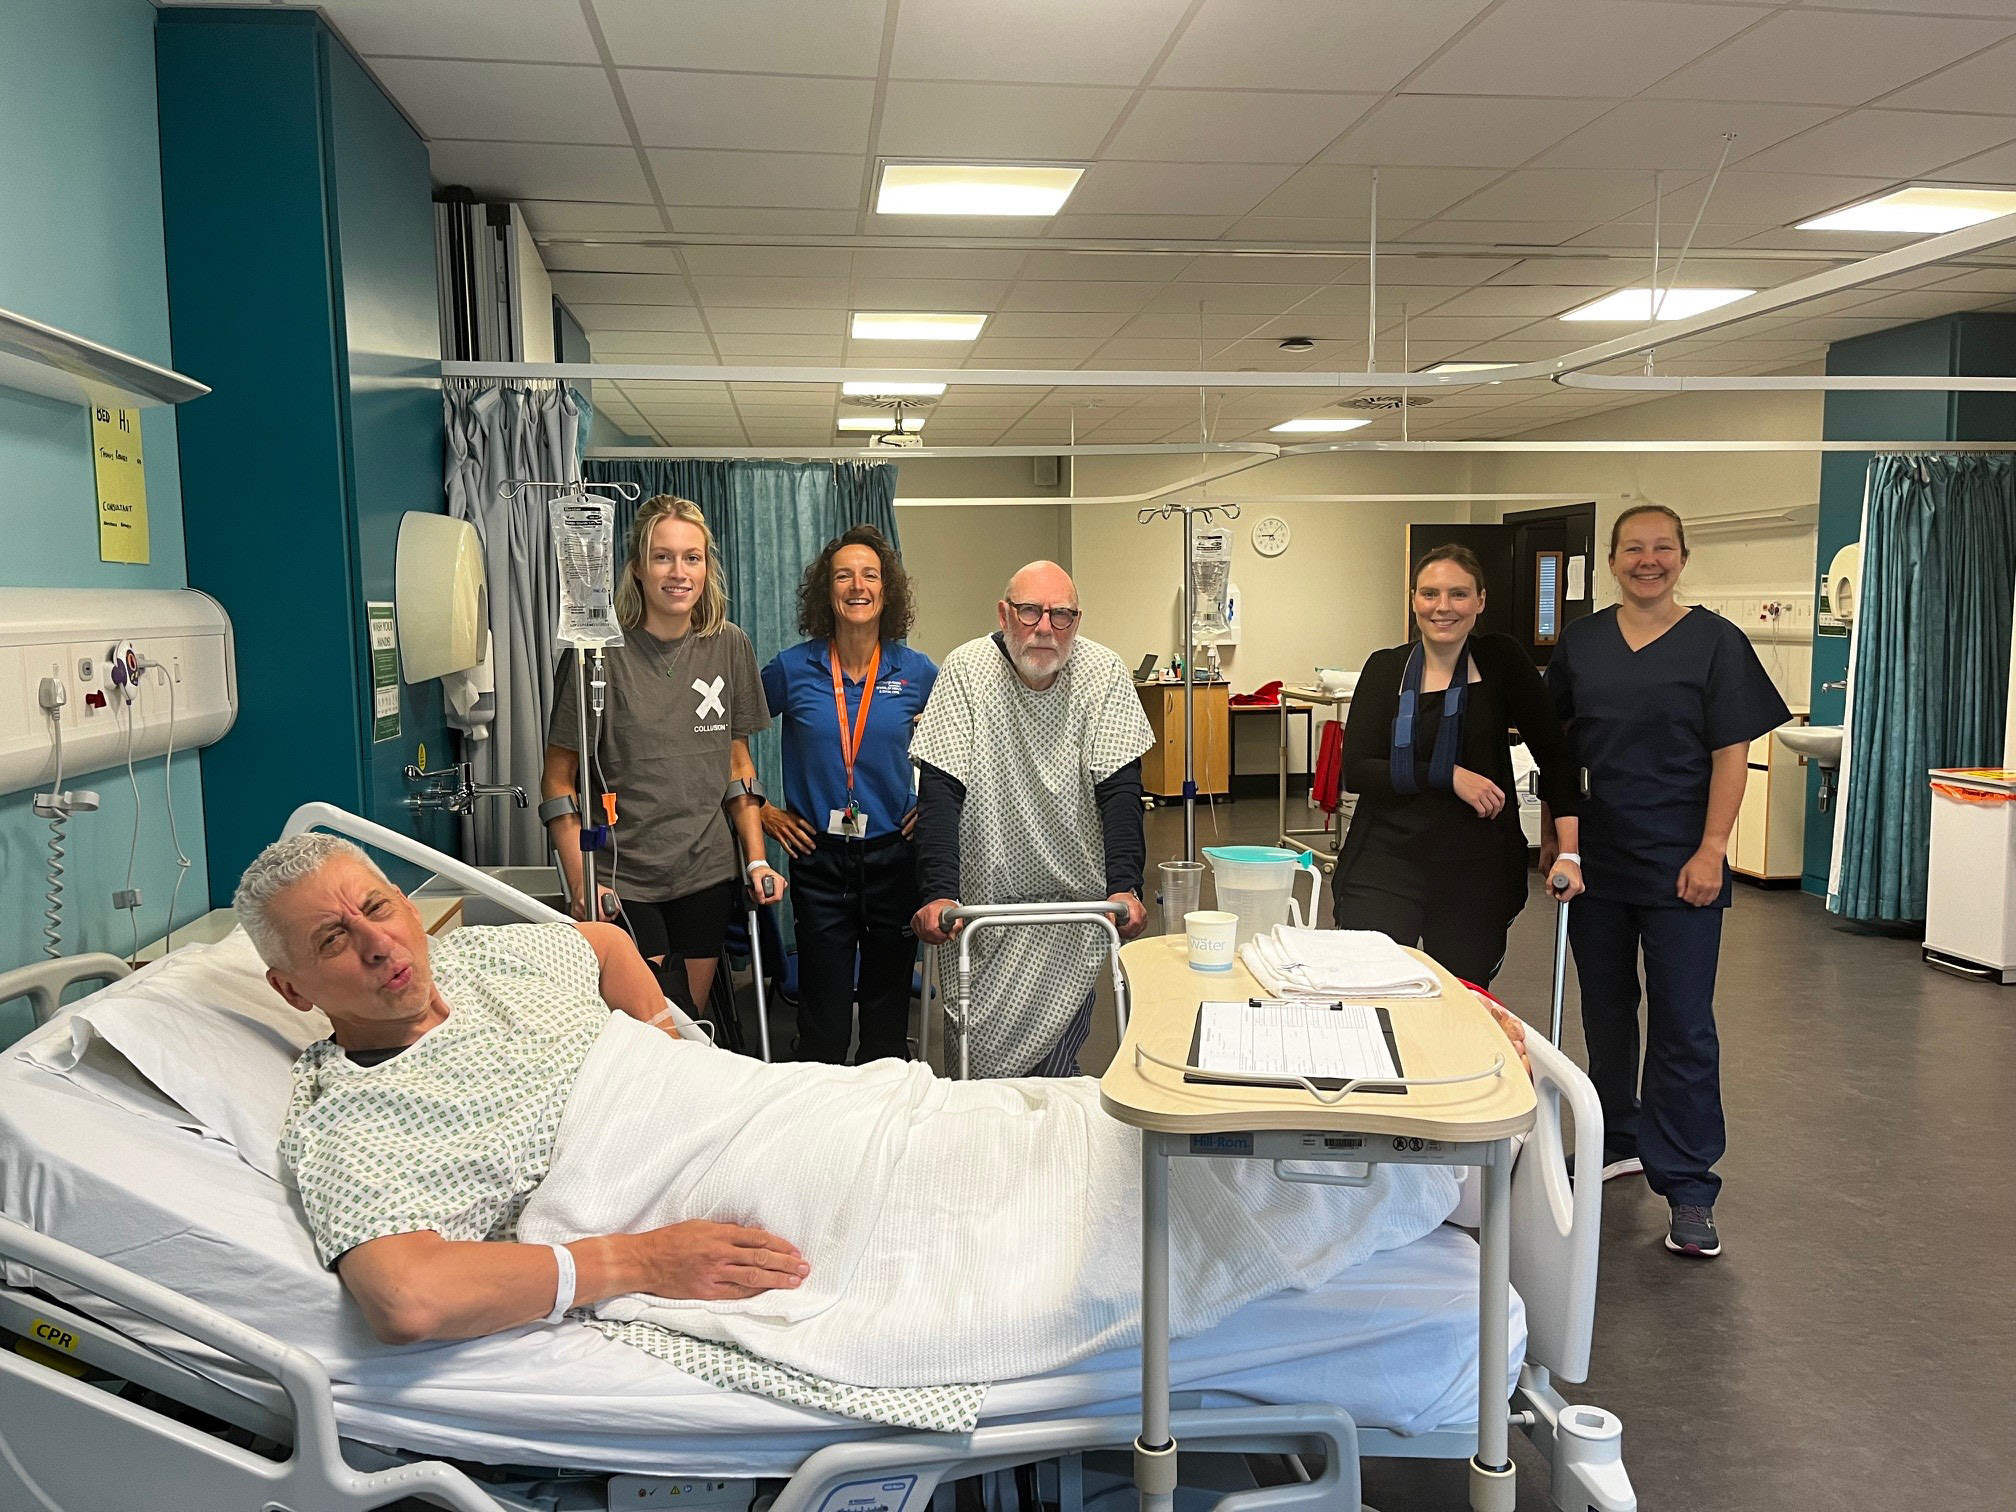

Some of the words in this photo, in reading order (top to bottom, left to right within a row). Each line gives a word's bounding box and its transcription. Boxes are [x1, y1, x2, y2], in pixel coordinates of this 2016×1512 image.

[1190, 939, 1226, 951] water
[1193, 1135, 1248, 1148] Hill-Rom
[36, 1324, 72, 1348] CPR
